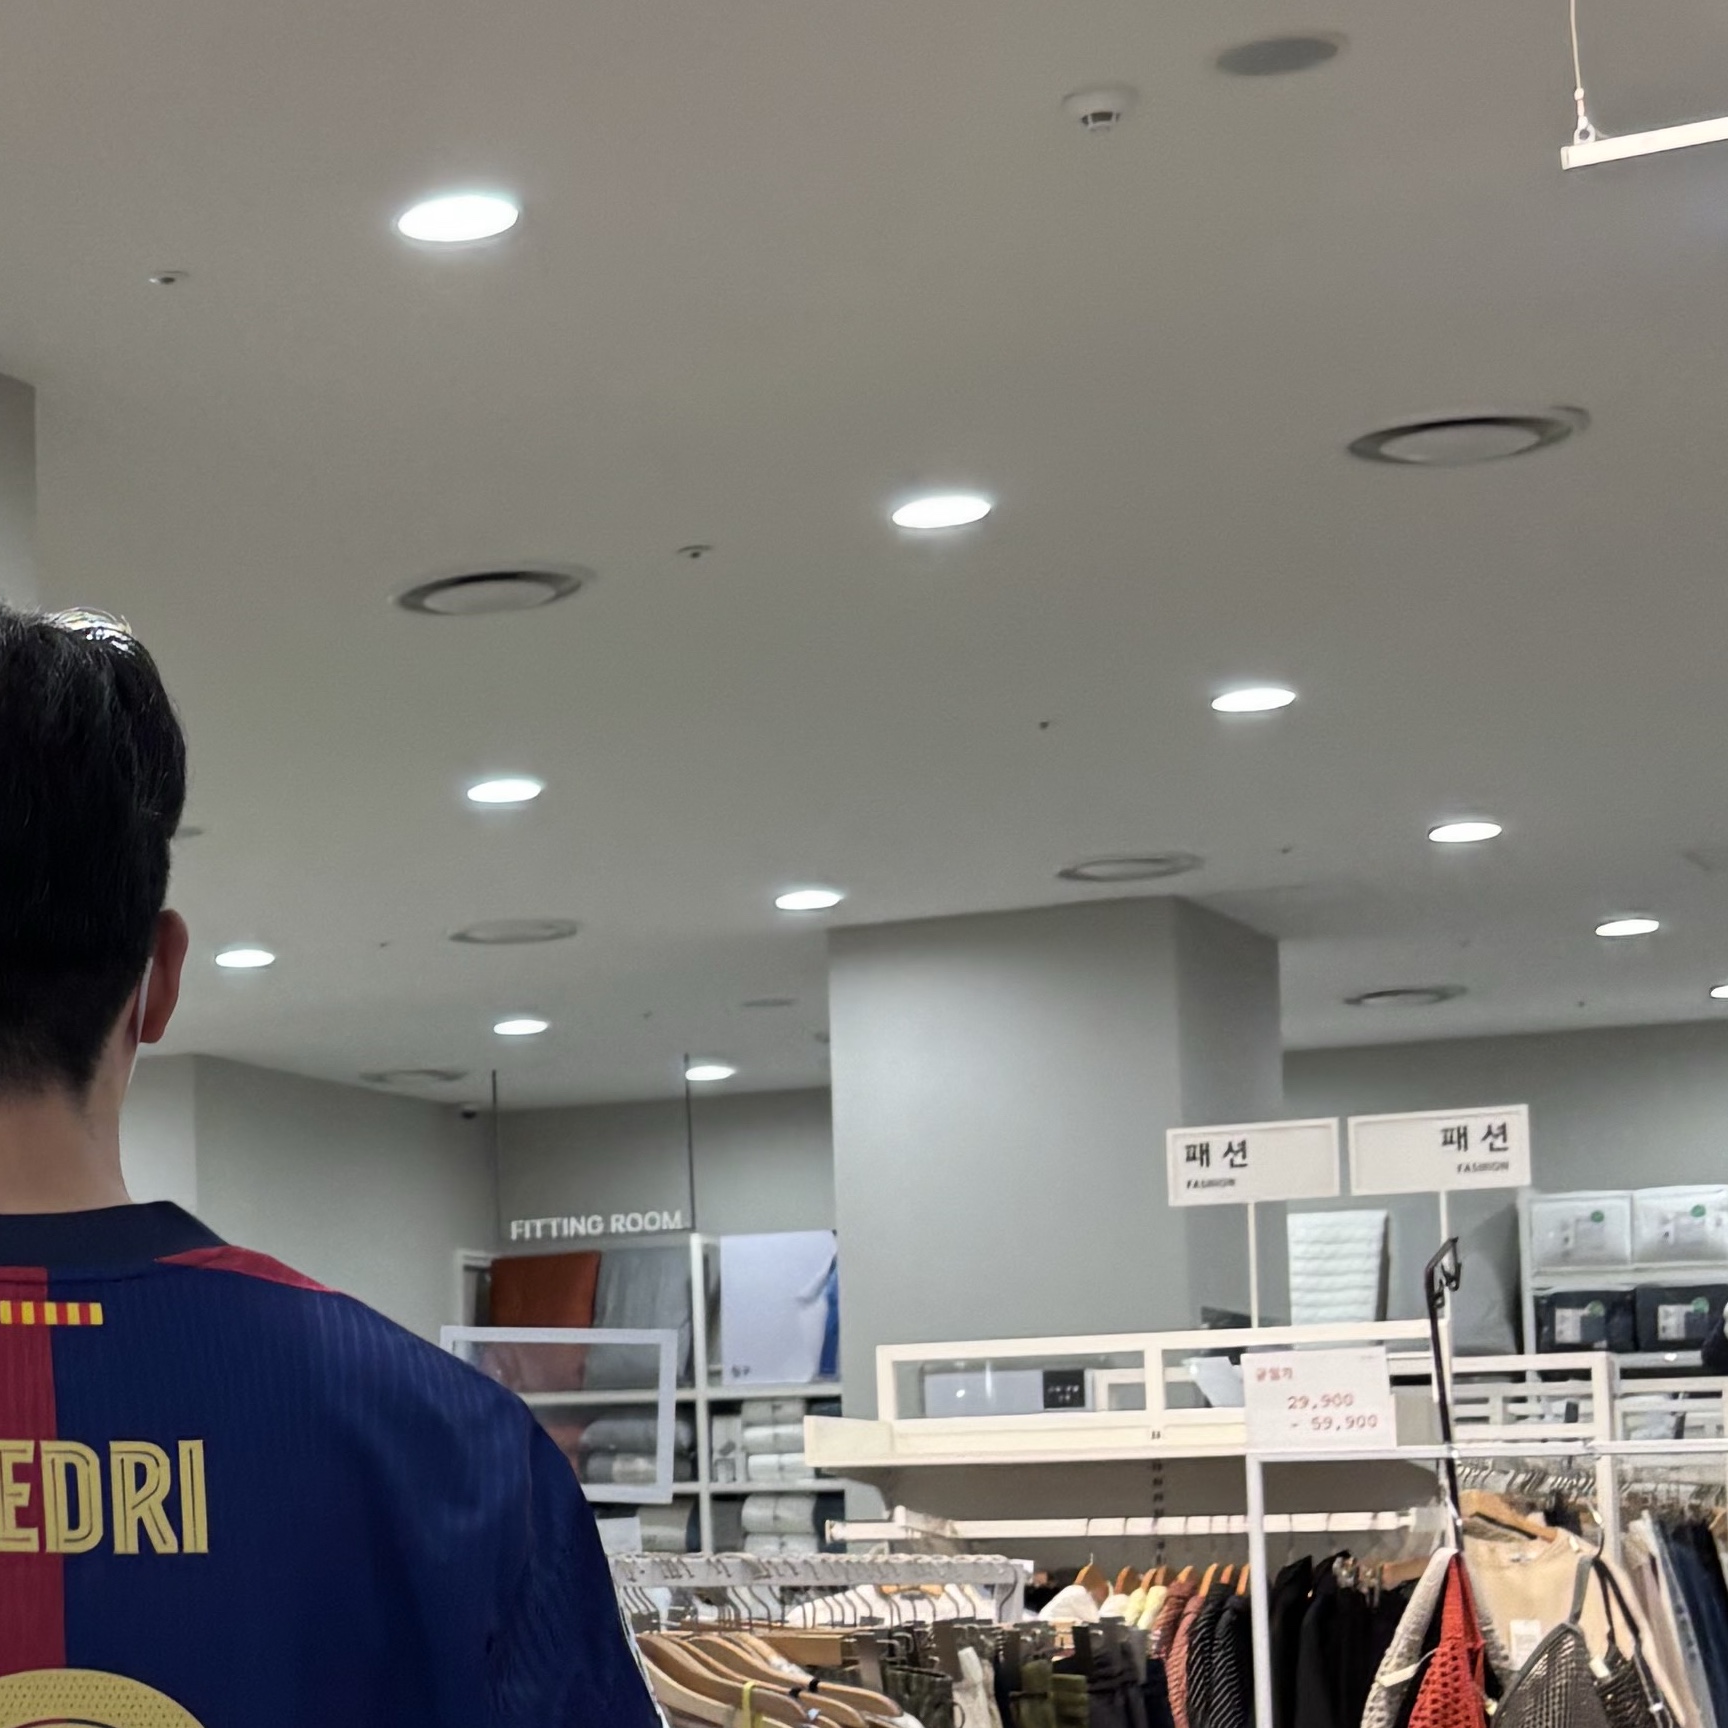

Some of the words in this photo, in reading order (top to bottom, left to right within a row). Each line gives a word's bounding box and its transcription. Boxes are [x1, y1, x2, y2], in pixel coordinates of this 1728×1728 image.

[510, 1213, 605, 1241] FITTING
[609, 1210, 684, 1234] ROOM
[1287, 1393, 1354, 1411] 29,900
[1310, 1414, 1378, 1432] 59,900
